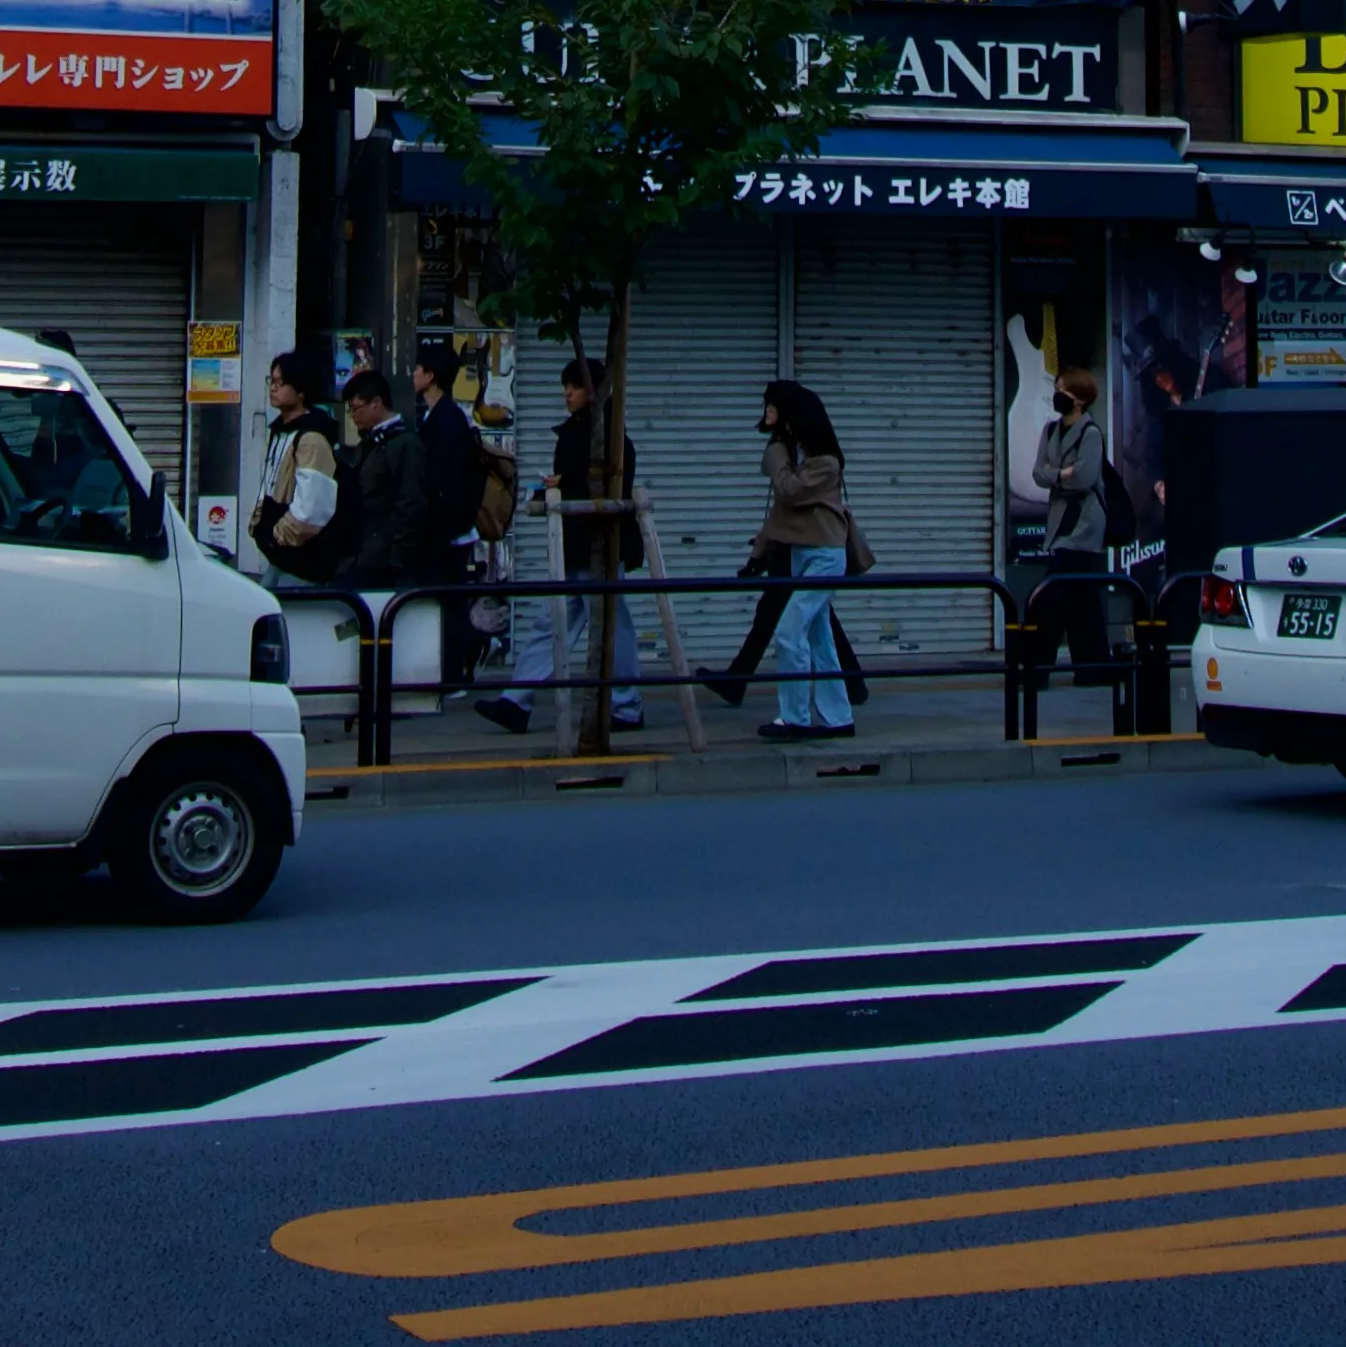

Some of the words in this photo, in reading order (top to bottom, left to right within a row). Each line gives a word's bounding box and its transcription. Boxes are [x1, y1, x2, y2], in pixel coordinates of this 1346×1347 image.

[788, 33, 1101, 103] PLANET
[888, 177, 1031, 210] エレキ本館
[1257, 309, 1295, 325] uitar
[1300, 309, 1346, 325] Floor
[1288, 611, 1335, 635] 55-15
